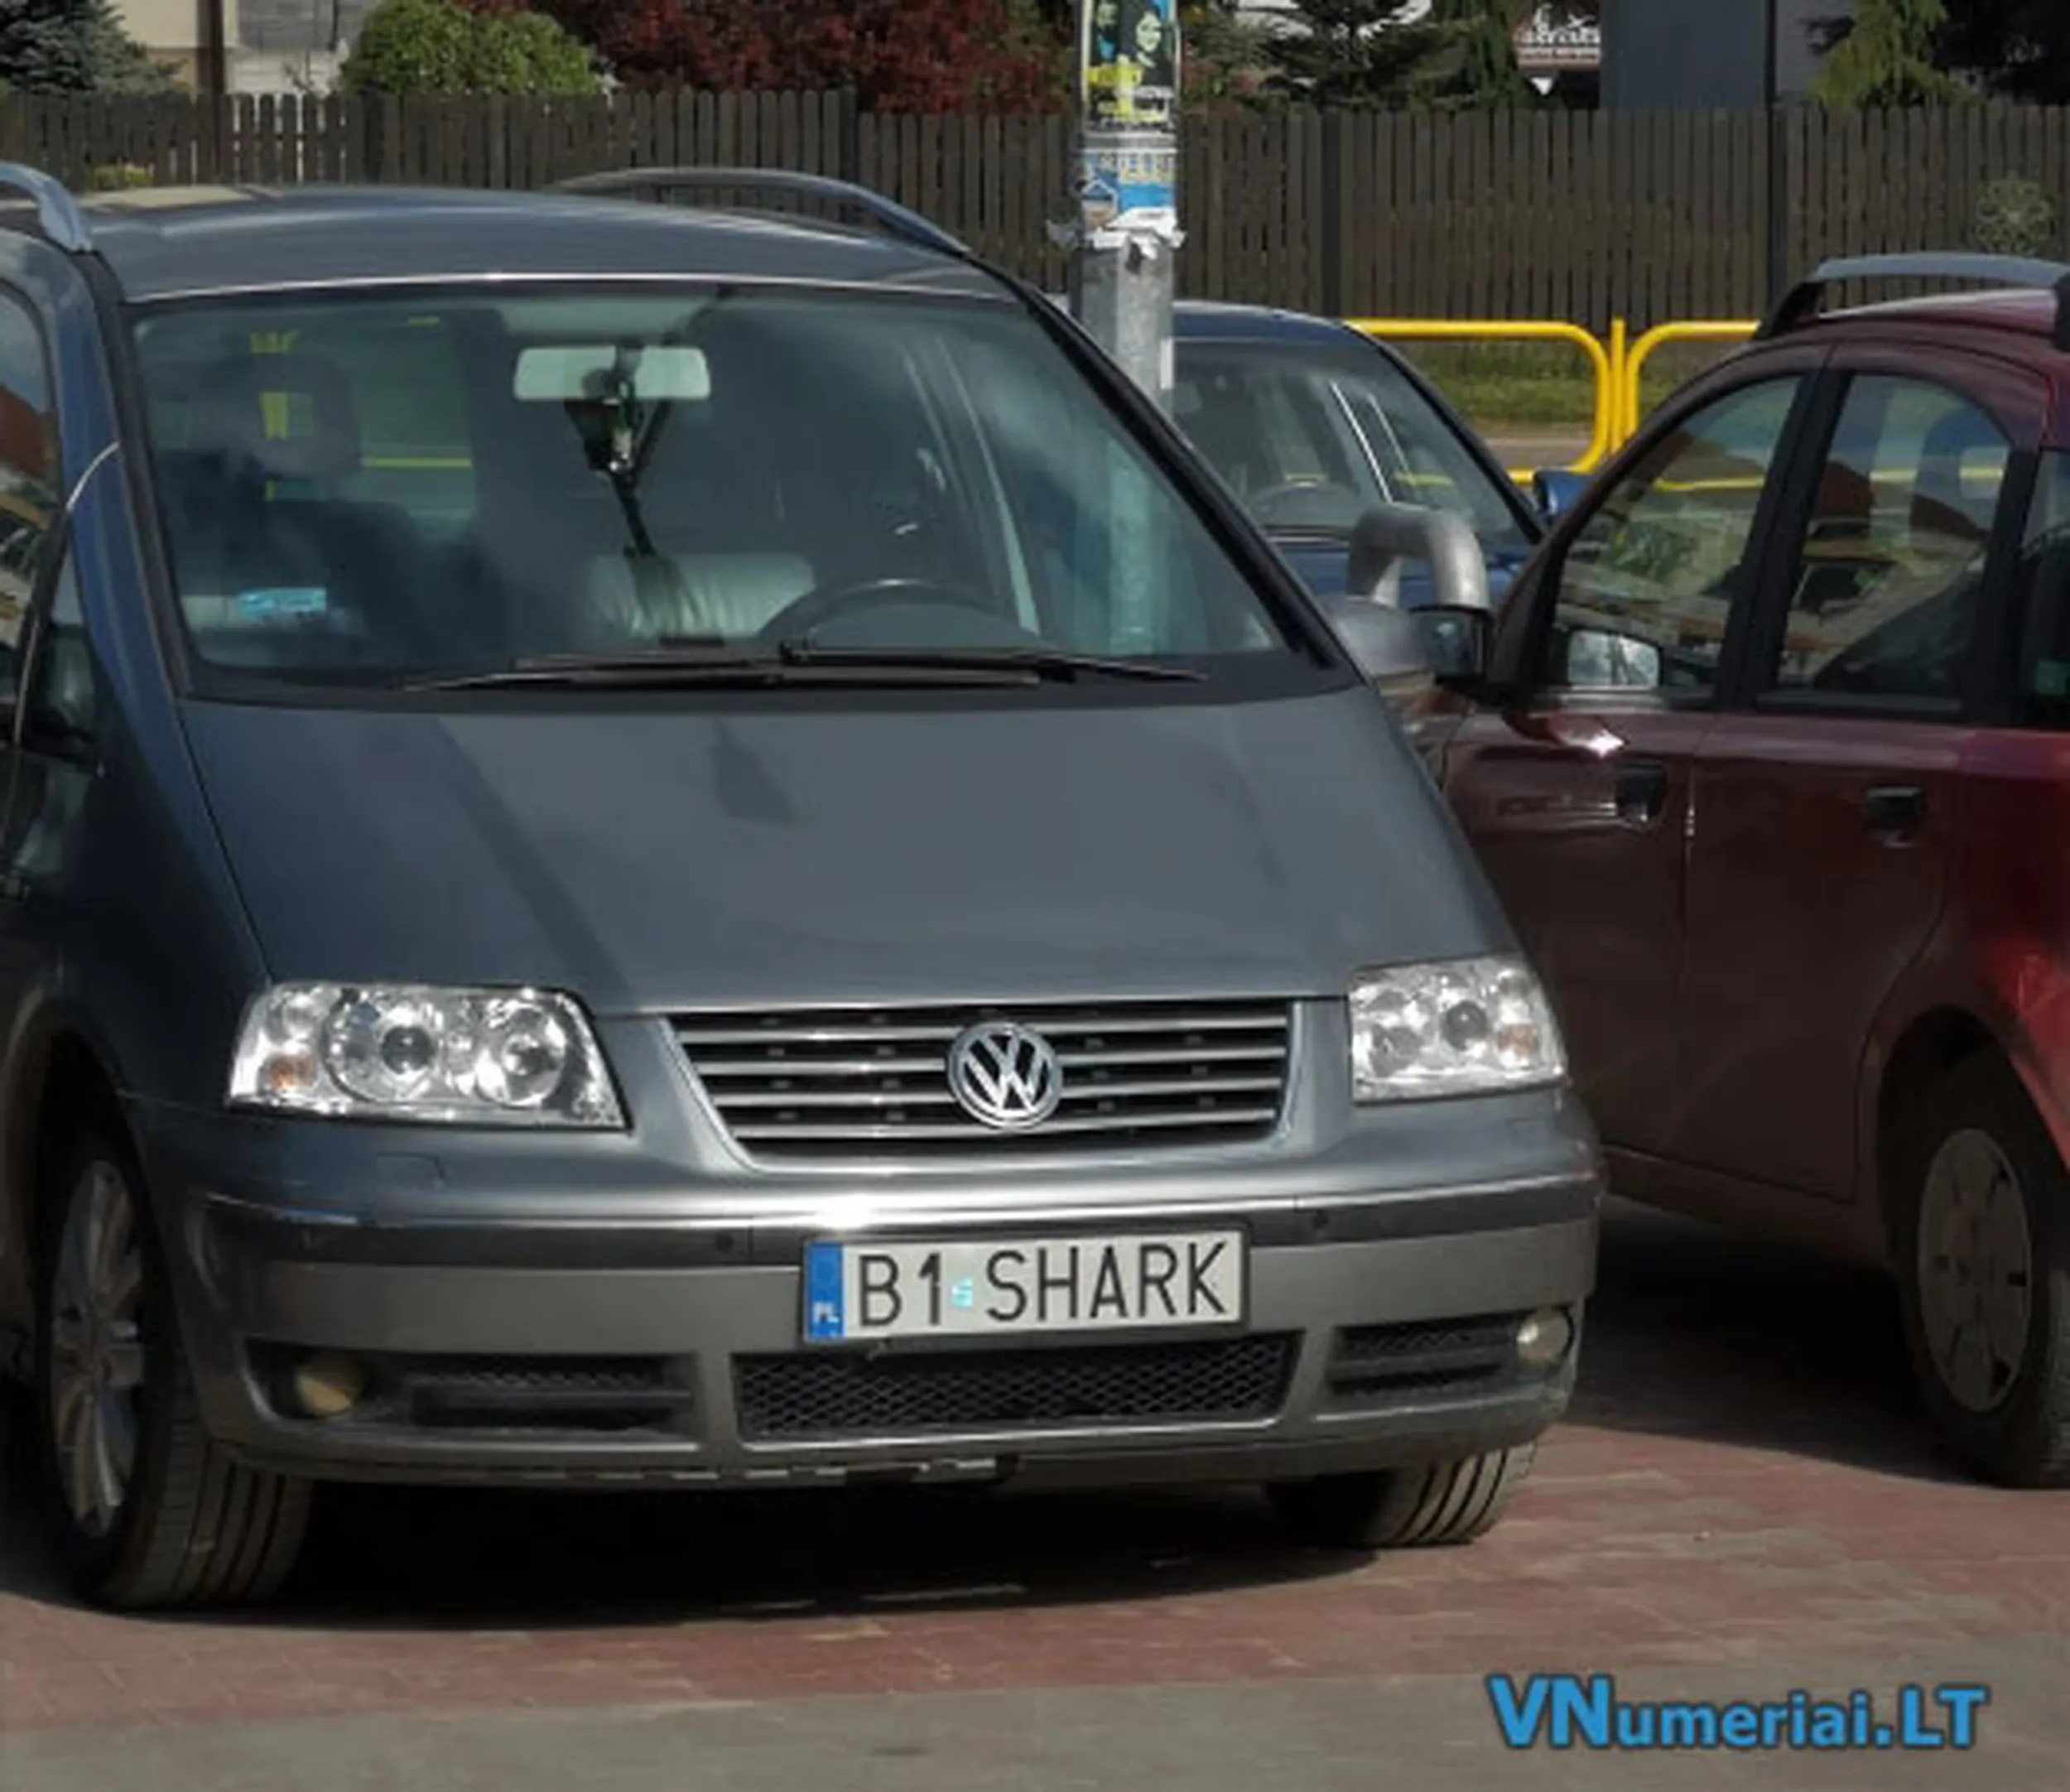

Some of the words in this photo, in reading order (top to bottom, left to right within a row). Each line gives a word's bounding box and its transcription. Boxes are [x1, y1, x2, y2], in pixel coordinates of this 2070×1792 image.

[955, 1028, 1057, 1121] VW
[859, 1251, 941, 1327] B1
[985, 1240, 1227, 1322] SHARK
